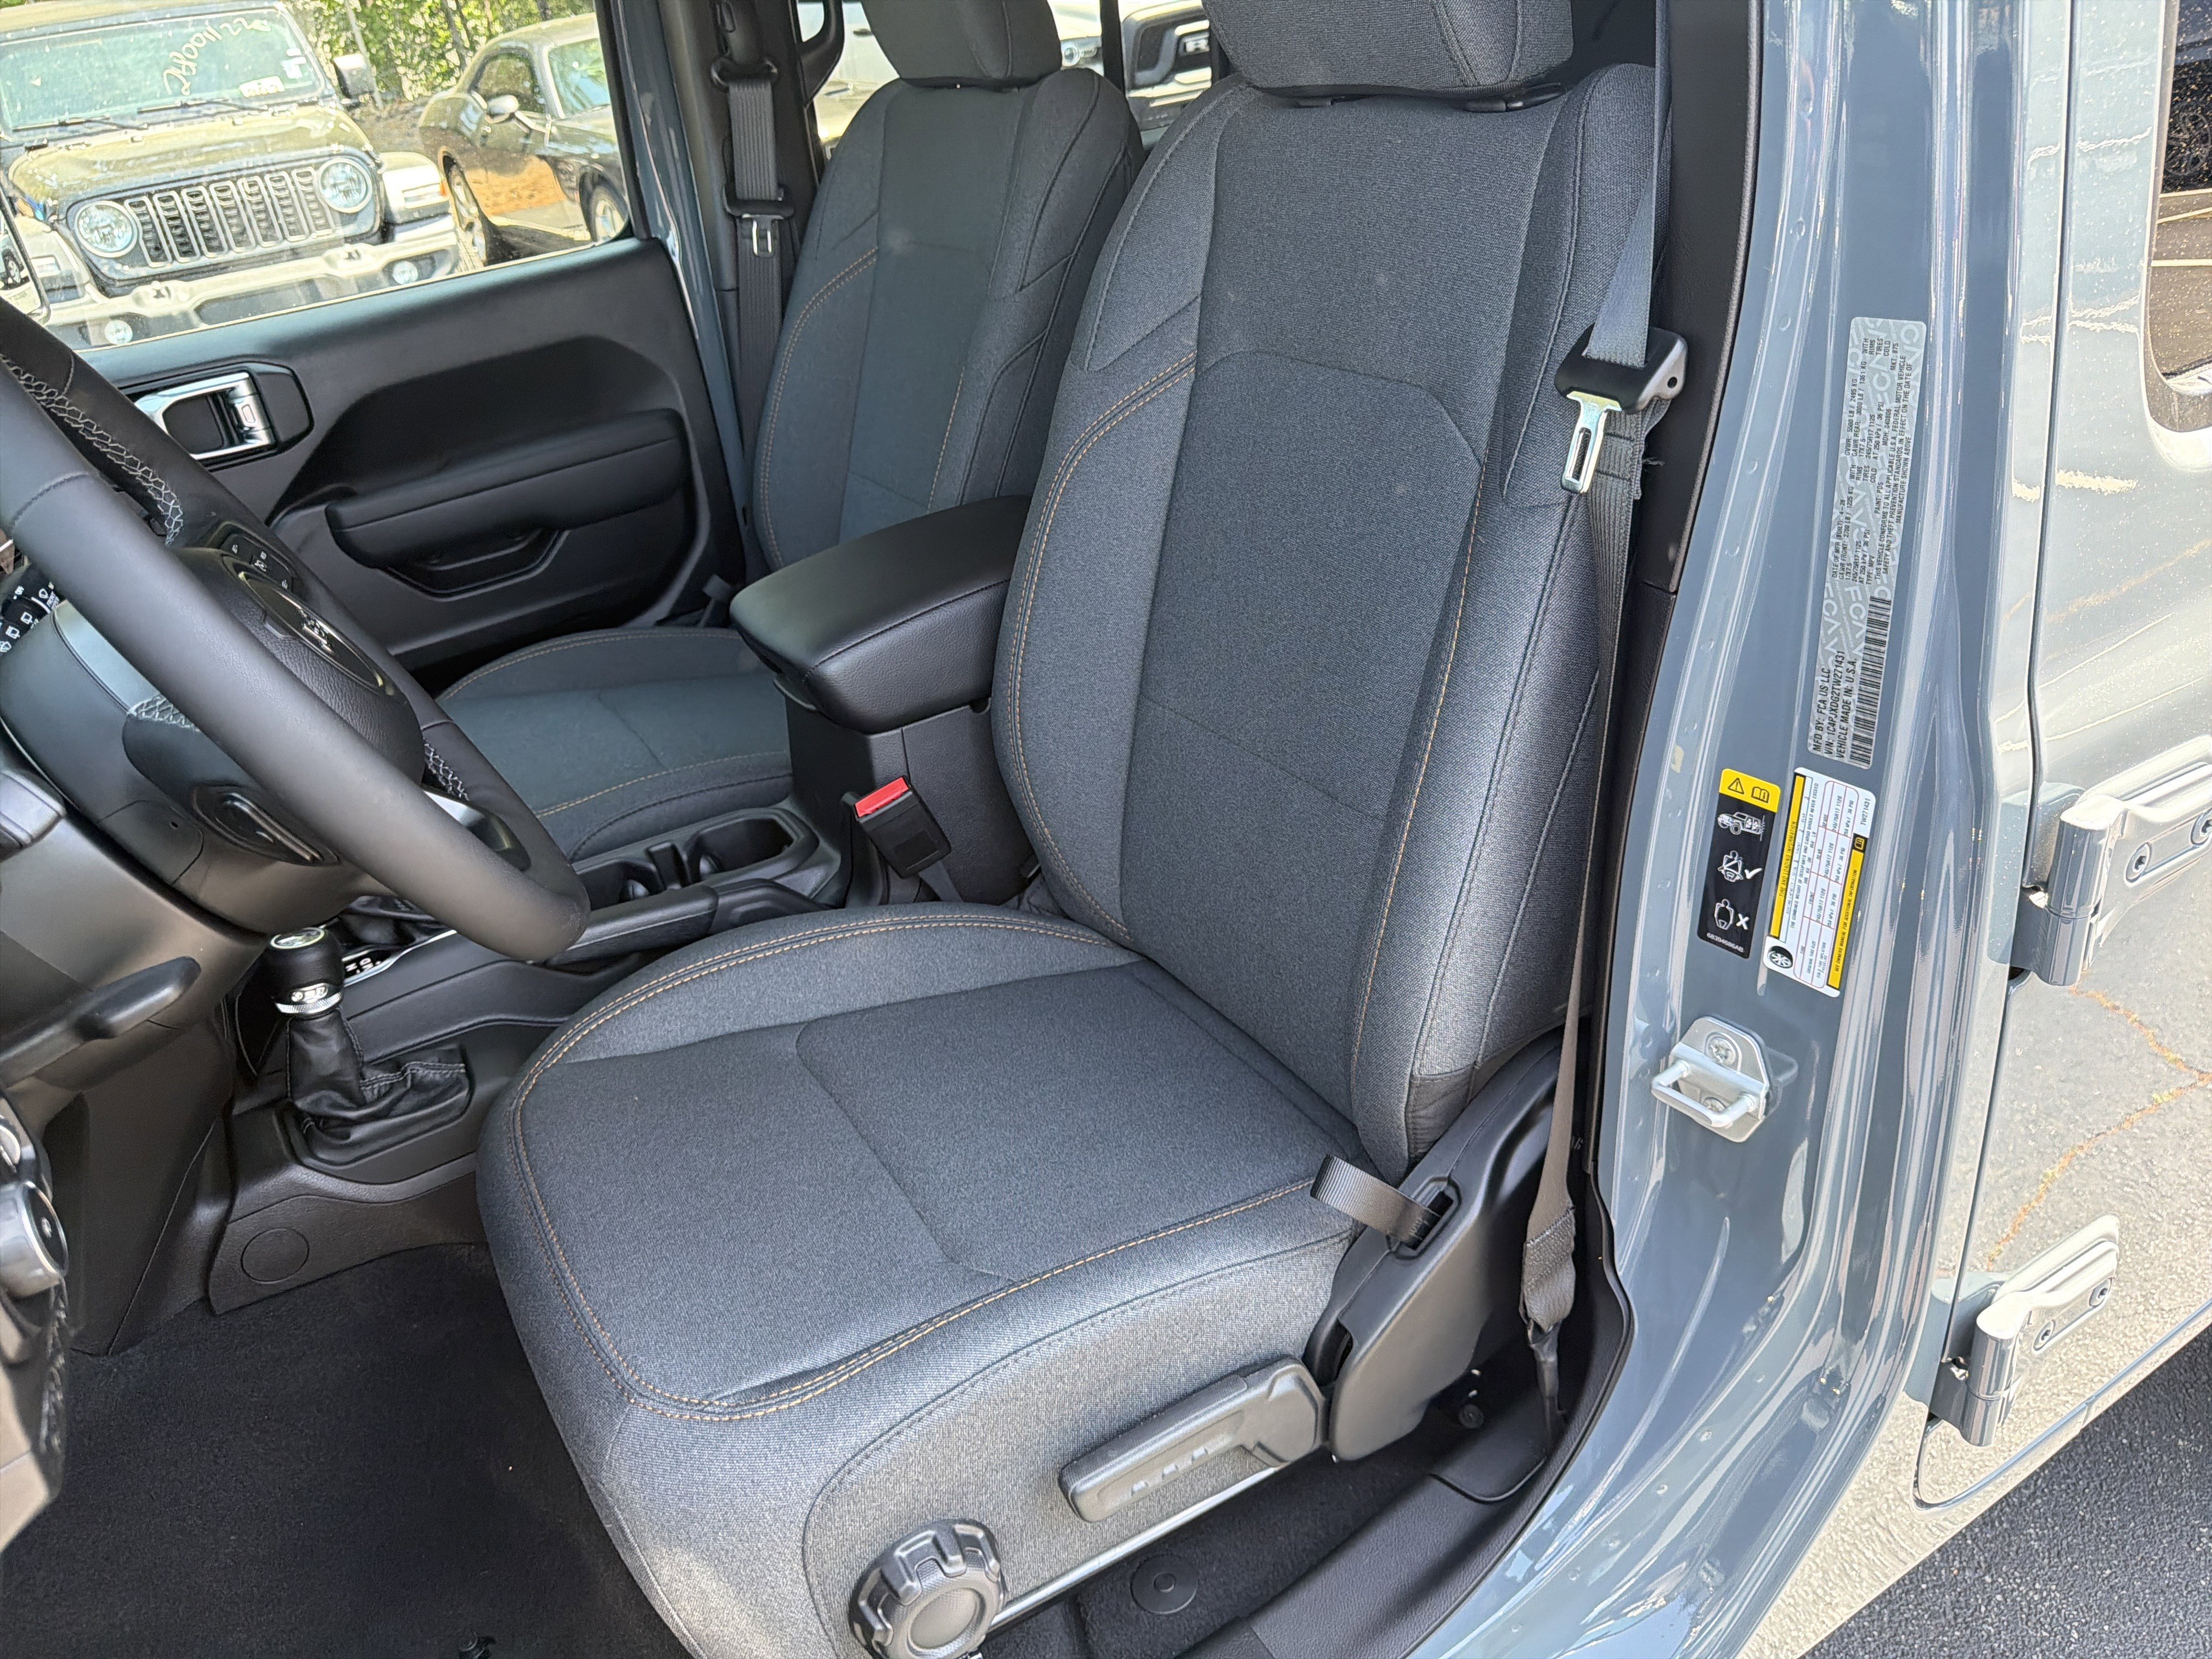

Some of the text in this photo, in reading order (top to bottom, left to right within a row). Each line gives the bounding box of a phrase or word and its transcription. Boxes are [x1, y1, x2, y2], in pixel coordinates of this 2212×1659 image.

[1897, 355, 1906, 380] VEHICLE
[1906, 363, 1913, 371] OF
[1851, 379, 1858, 387] KG
[1894, 382, 1903, 403] MOTOR
[1891, 405, 1900, 432] FEDERAL
[1901, 404, 1908, 413] ON
[1898, 414, 1906, 436] EFFECT
[1865, 428, 1874, 459] 245/75R17
[1889, 433, 1897, 452] U.S.A.
[1872, 452, 1878, 460] AT
[1893, 446, 1903, 481] STANDARDS
[1900, 458, 1909, 479] SHOWN
[1885, 453, 1895, 488] APPLICABLE
[1888, 483, 1899, 518] PREVENTION
[1895, 480, 1906, 523] MANUFACTURE
[1835, 518, 1843, 540] (BUILT):
[1878, 511, 1888, 541] CONFORMS
[1833, 554, 1839, 562] OF
[1876, 543, 1884, 566] VEHICLE
[1882, 552, 1890, 574] SAFETY
[1852, 554, 1860, 582] 245/75R17
[1826, 650, 1844, 736] 1C4PJXDG2TW271431
[1812, 667, 1830, 752] MFD BY: FCA US LLC
[1836, 656, 1857, 759] VEHICLE MADE IN: U.S.A.
[1824, 737, 1835, 755] VIN:
[1860, 798, 1870, 825] TW271431
[1786, 821, 1796, 853] INFORMATION
[1844, 898, 1852, 921] ADDITIONAL
[1848, 869, 1858, 896] INFORMATION
